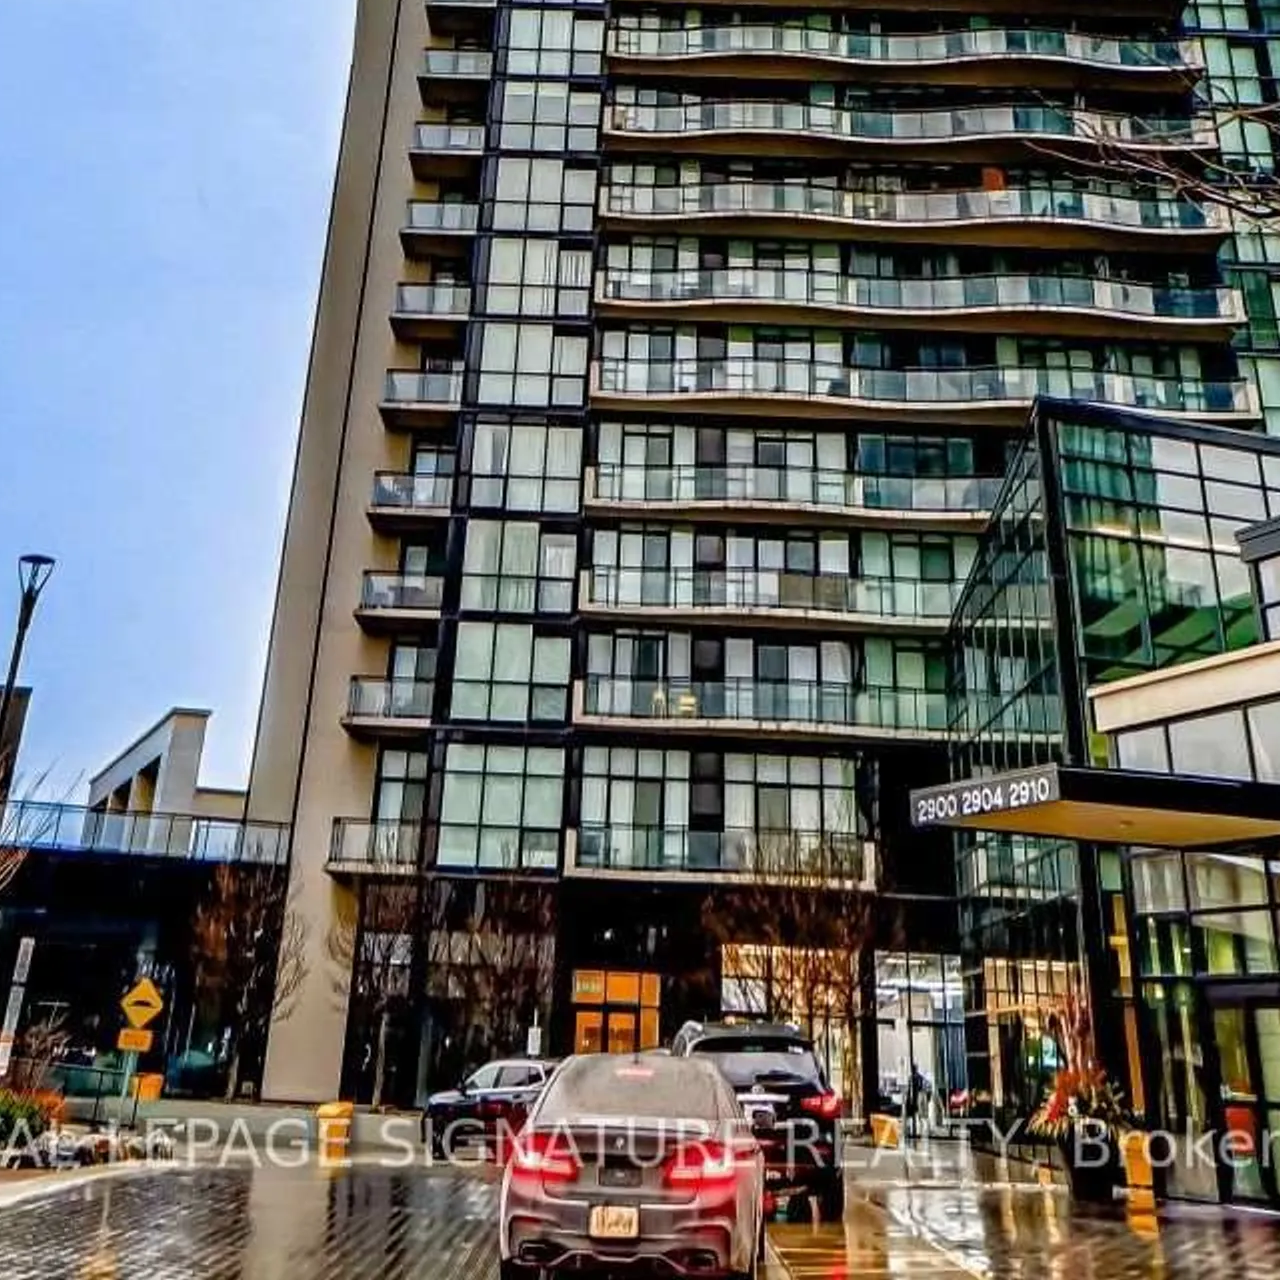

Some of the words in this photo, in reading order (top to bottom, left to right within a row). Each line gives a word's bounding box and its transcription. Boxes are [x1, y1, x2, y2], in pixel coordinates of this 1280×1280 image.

[917, 795, 958, 821] 2900
[962, 786, 1003, 814] 2904
[1009, 777, 1049, 807] 2910
